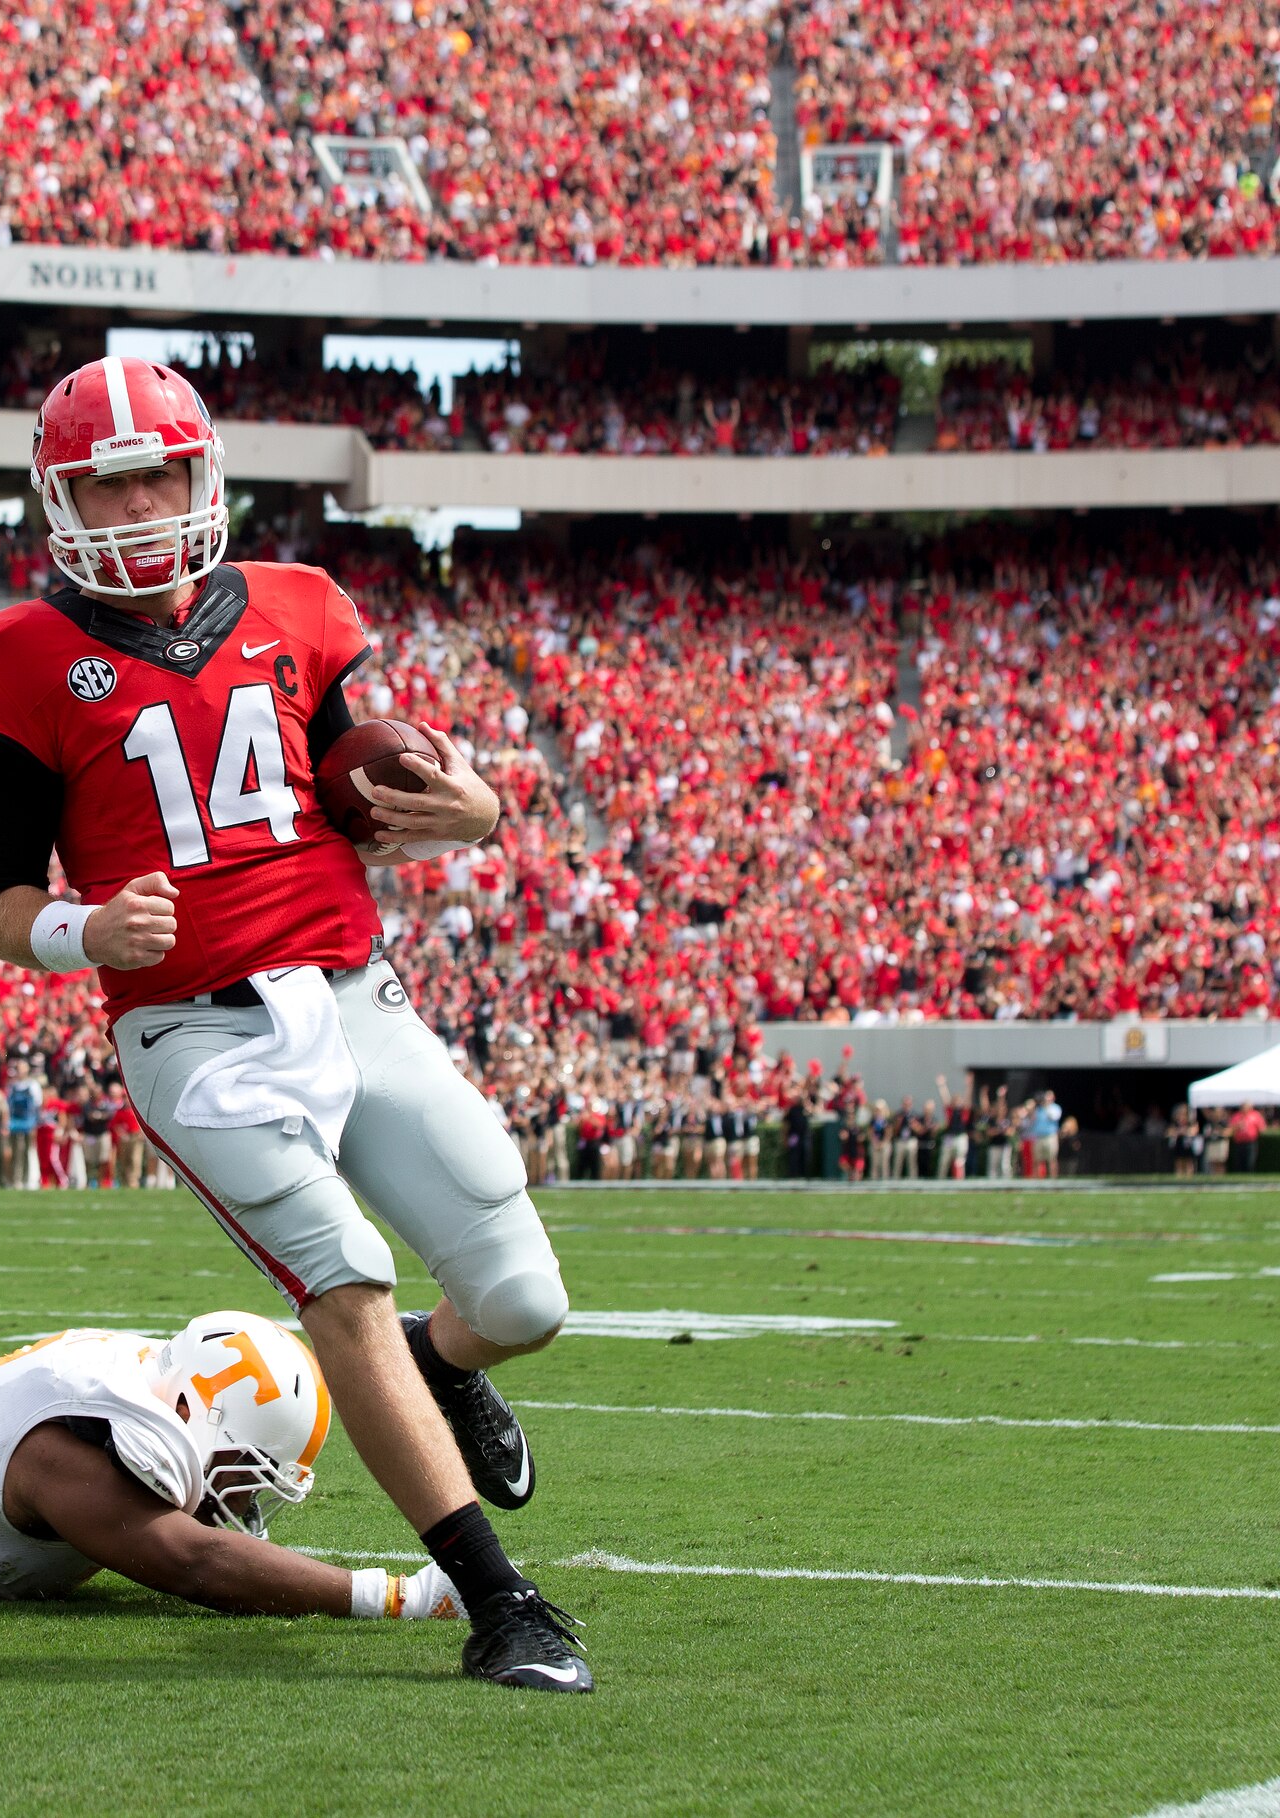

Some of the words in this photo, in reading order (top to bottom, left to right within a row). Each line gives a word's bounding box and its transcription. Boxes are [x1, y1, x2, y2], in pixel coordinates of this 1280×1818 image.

[30, 261, 157, 291] NORTH
[110, 438, 144, 449] DAWGS
[71, 659, 113, 699] SEC
[274, 655, 298, 697] C
[123, 682, 302, 870] 14
[377, 979, 407, 1008] G
[190, 1331, 282, 1410] T
